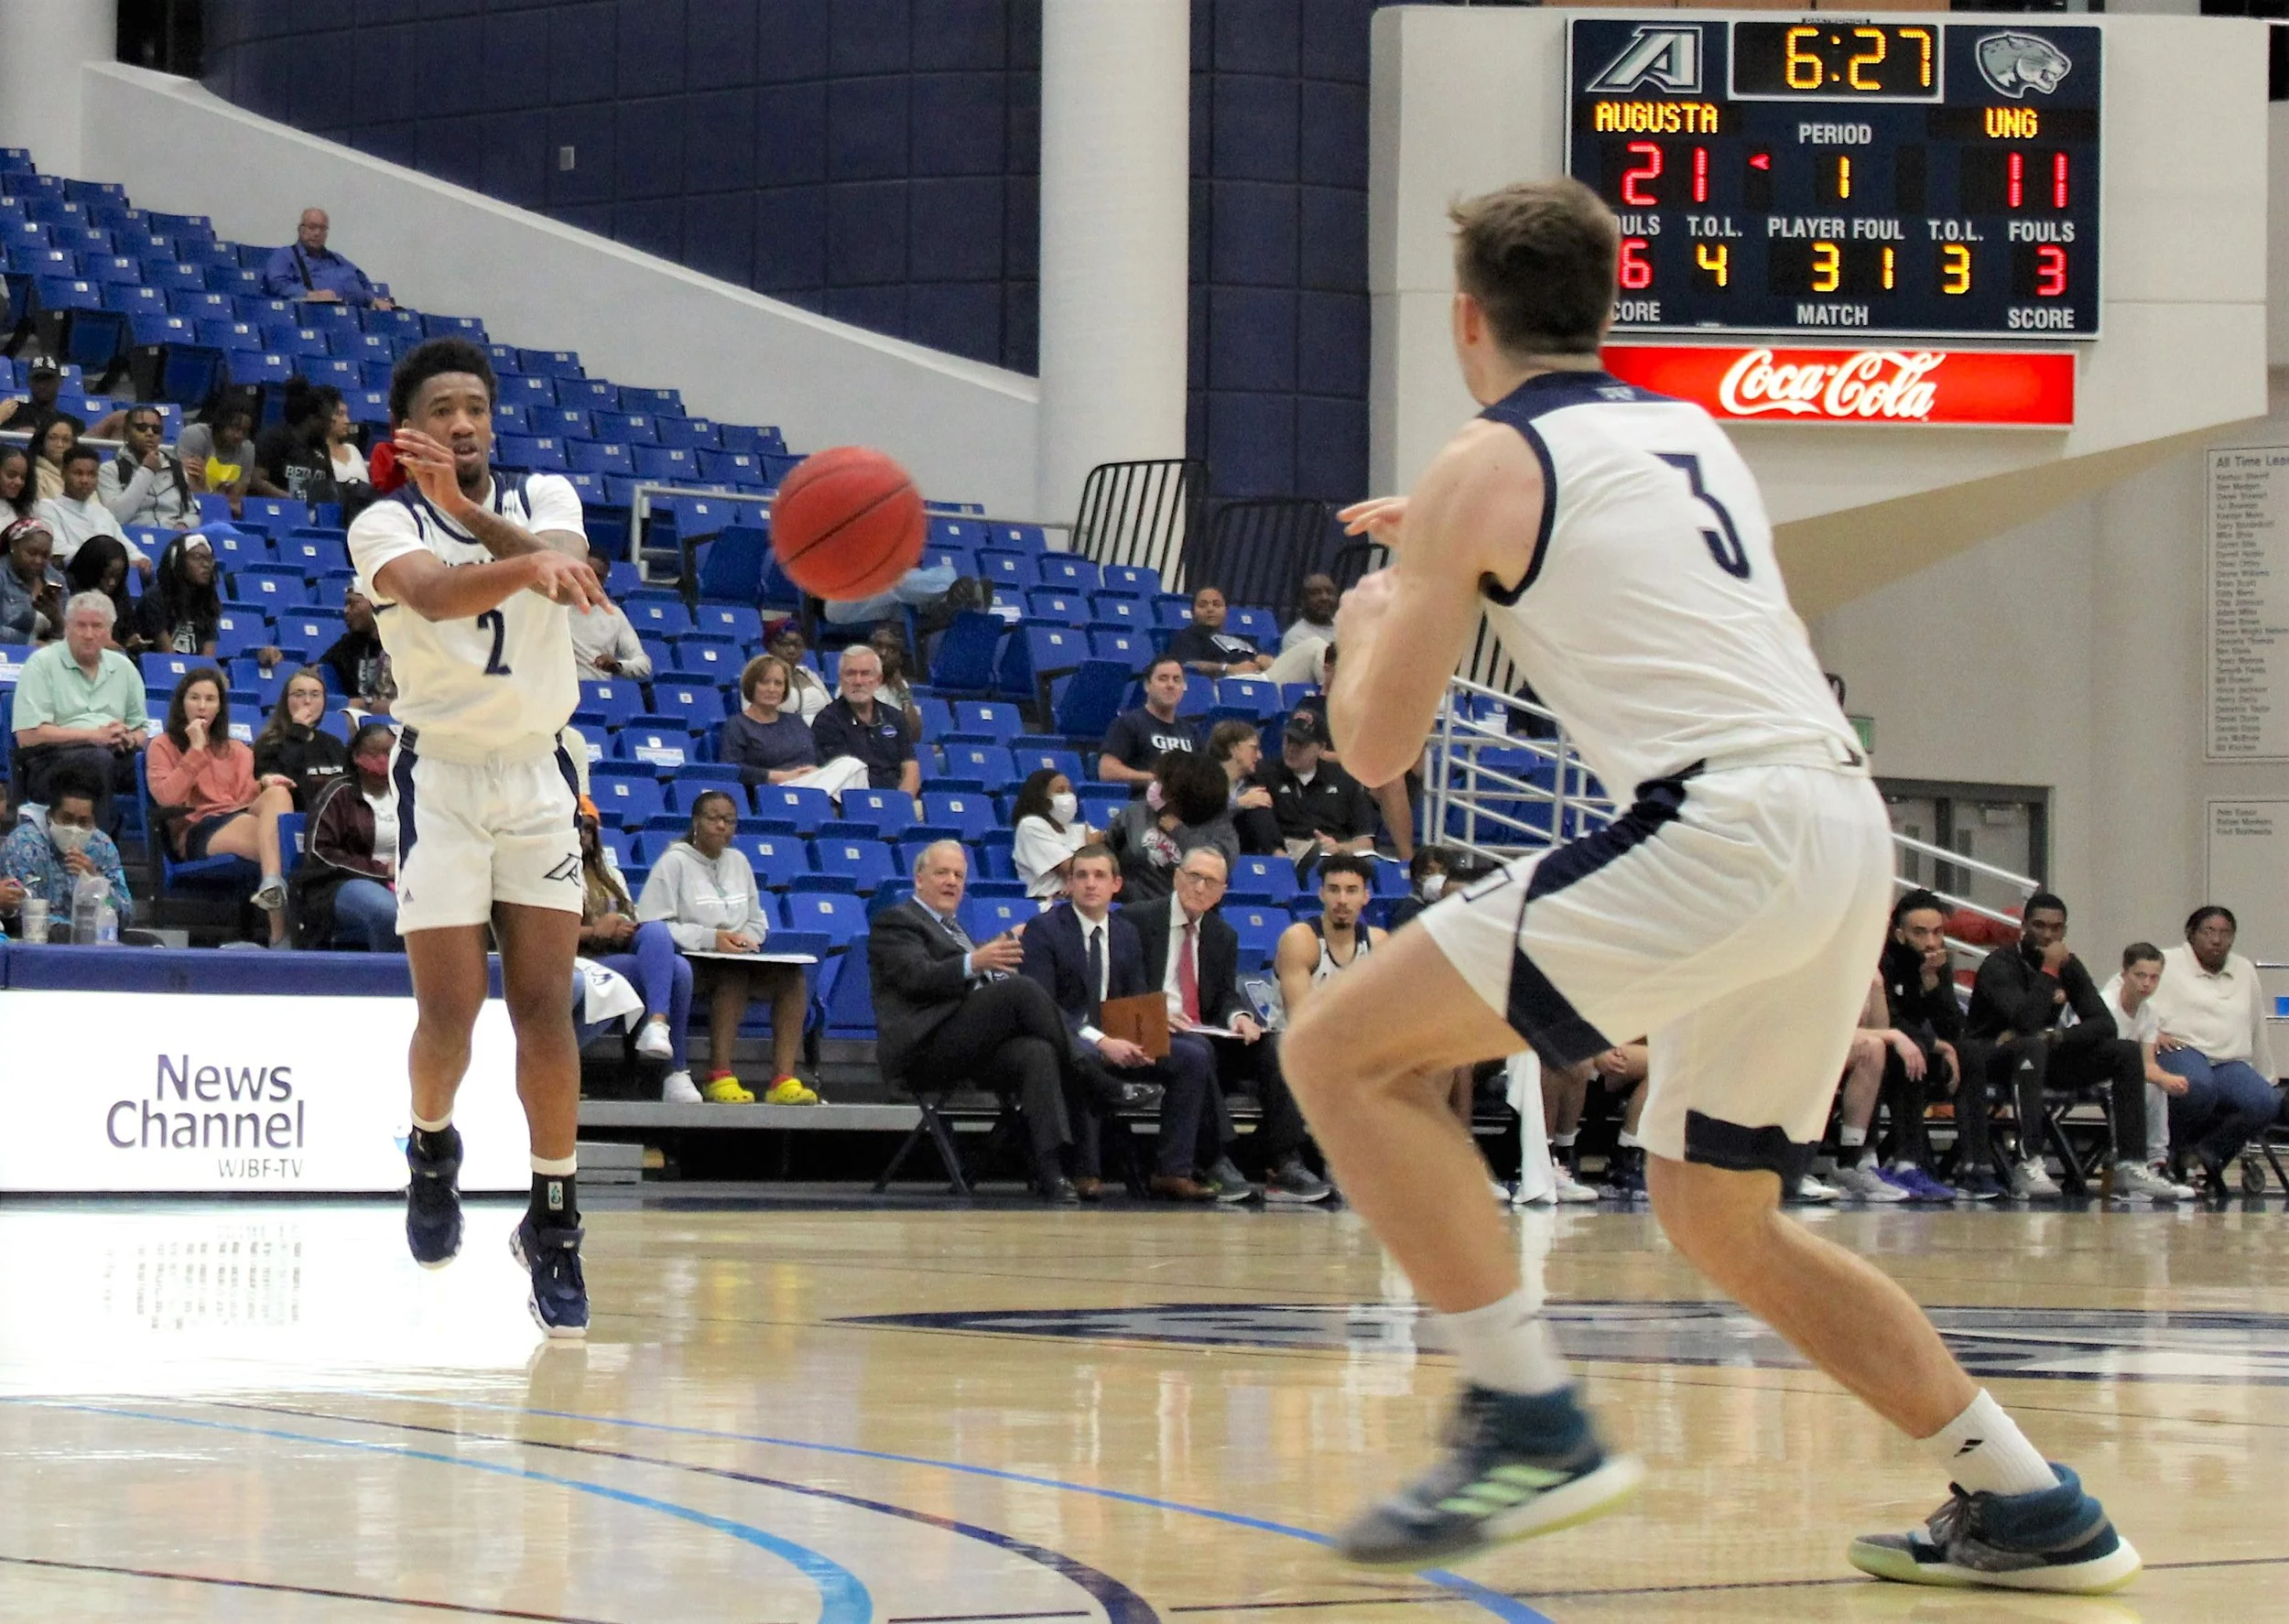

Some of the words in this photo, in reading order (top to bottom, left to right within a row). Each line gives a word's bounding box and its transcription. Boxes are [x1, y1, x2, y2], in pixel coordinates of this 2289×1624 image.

[1785, 27, 1932, 91] 6:27
[1594, 102, 1719, 135] AUGUSTA
[1798, 124, 1871, 146] PERIOD
[1985, 108, 2038, 139] UNG
[1622, 141, 1709, 206] 21
[1837, 156, 1850, 199] 1
[2007, 152, 2069, 210] 11
[1687, 216, 1743, 236] T.O.L.
[1767, 218, 1846, 239] PLAYER
[1852, 220, 1905, 240] FOUL
[1927, 220, 1984, 242] T.O.L.
[2008, 221, 2076, 243] FOULS
[1620, 239, 1653, 288] 6
[1697, 244, 1728, 287] 4
[1812, 242, 1840, 292] 3
[1943, 244, 1970, 295] 3
[2036, 244, 2067, 296] 3
[1611, 300, 1661, 321] CORE
[1796, 304, 1869, 326] MATCH
[2008, 308, 2076, 330] SCORE
[2235, 456, 2262, 467] Time
[1646, 450, 1752, 580] 3
[477, 609, 513, 676] 2
[157, 1054, 293, 1102] News
[106, 1099, 305, 1149] Channel
[218, 1158, 304, 1178] WJBF-TV
